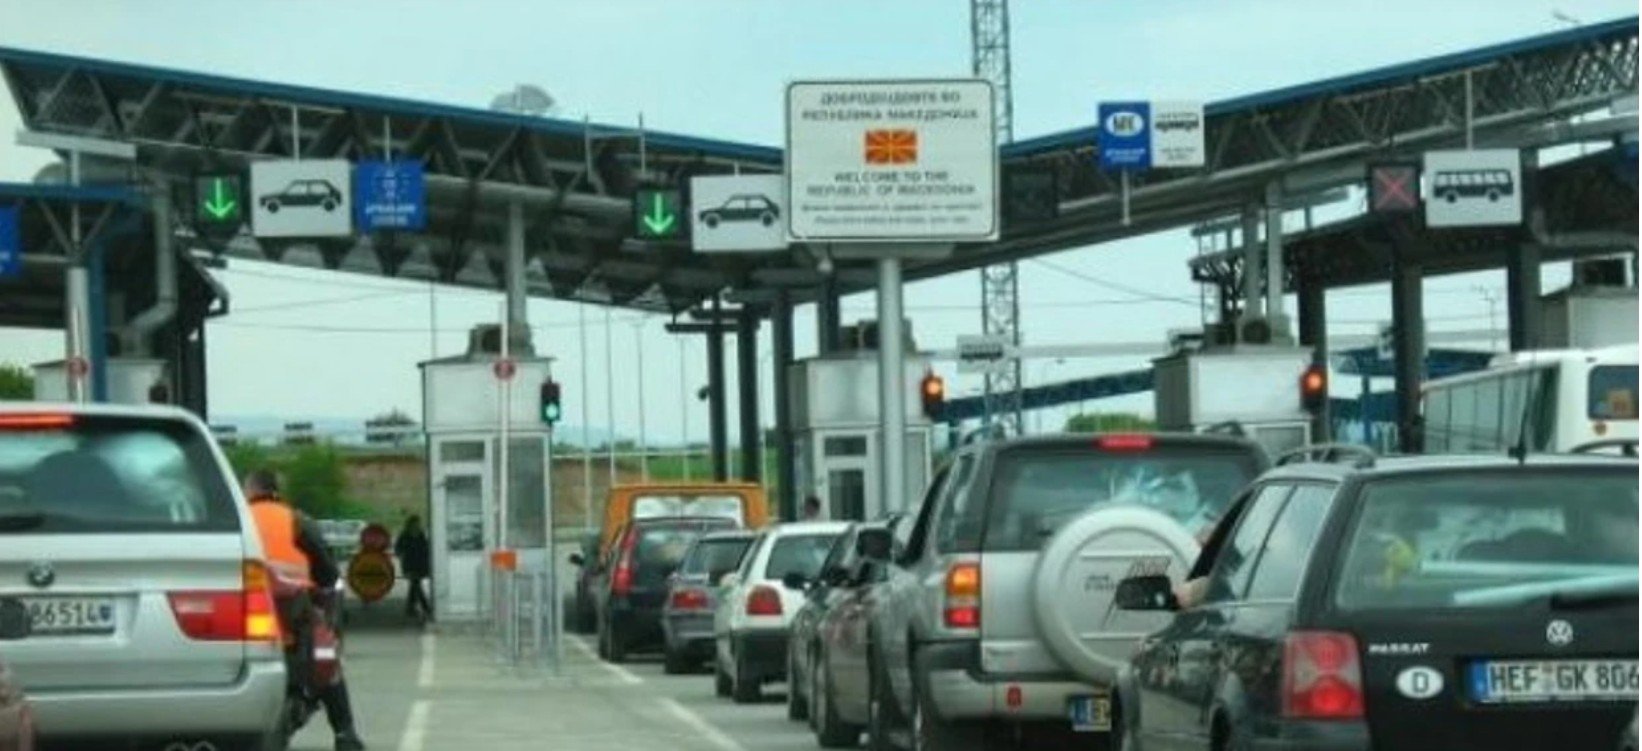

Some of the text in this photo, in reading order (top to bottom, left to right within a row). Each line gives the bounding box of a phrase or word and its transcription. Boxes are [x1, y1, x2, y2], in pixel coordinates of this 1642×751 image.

[834, 170, 948, 183] WELCOME TO THE
[806, 184, 976, 196] REPUBLIC OF MACEDONIA
[1412, 671, 1429, 693] D
[1490, 666, 1538, 692] HEF
[1556, 665, 1587, 692] GK
